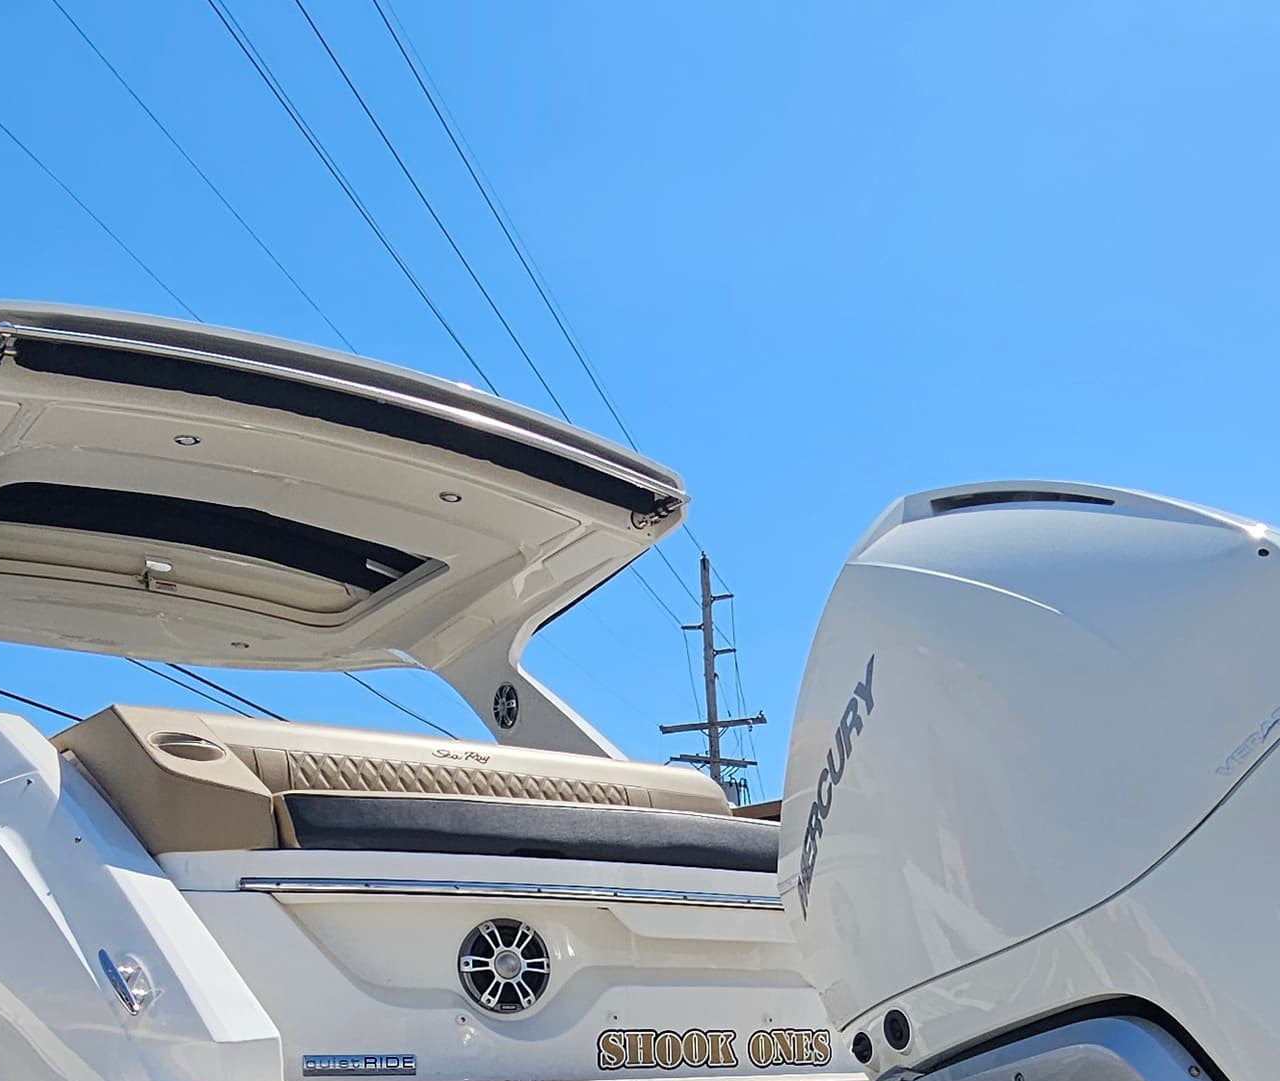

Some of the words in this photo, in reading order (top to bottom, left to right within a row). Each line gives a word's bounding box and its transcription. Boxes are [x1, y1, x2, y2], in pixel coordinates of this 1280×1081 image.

[431, 749, 462, 760] Sea
[464, 751, 490, 764] Ray
[797, 653, 875, 922] MERCURY
[597, 1028, 738, 1071] SHOOK
[748, 1028, 832, 1067] ONES
